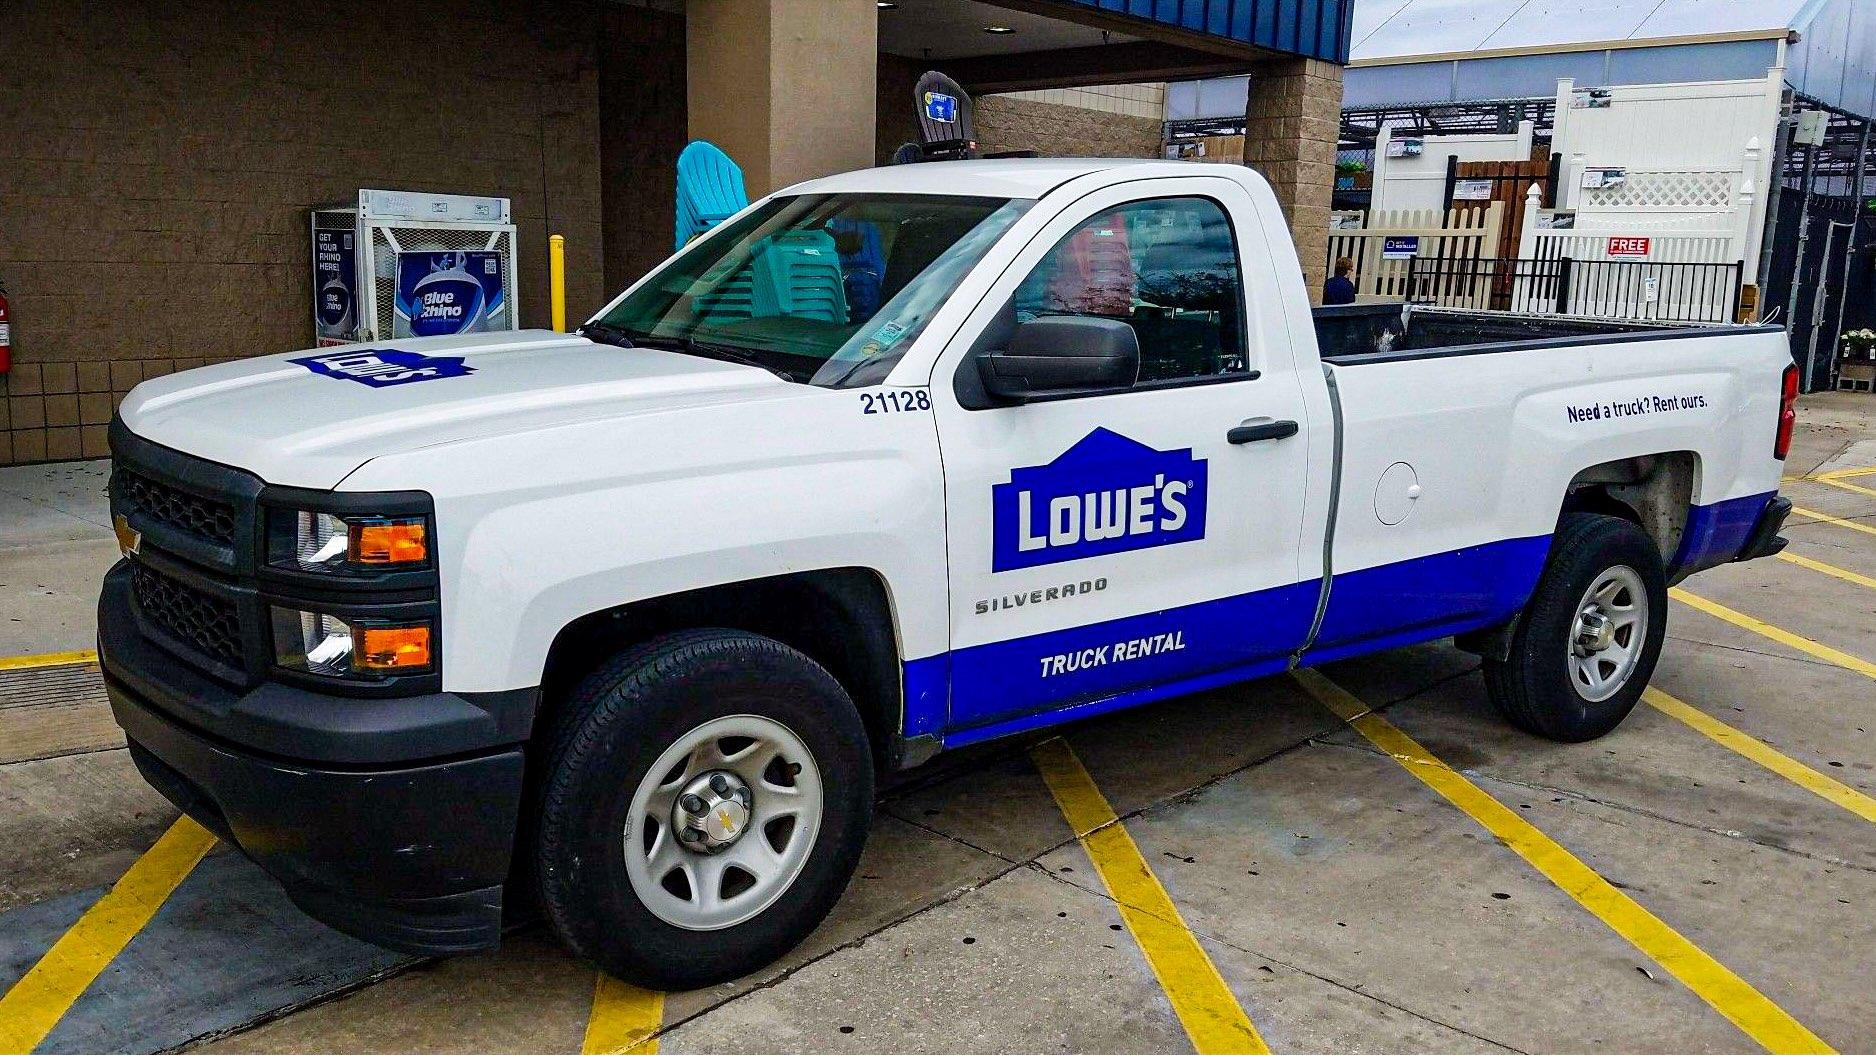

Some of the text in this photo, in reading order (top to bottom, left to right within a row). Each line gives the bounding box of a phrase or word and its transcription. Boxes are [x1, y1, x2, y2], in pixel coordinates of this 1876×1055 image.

[319, 233, 332, 242] GET
[319, 243, 337, 252] YOUR
[1609, 238, 1646, 251] FREE
[319, 252, 341, 262] RHINO
[860, 389, 931, 415] 21128
[1566, 394, 1708, 423] Need a truck? Rent ours.
[1017, 473, 1188, 552] LOWE'S
[974, 577, 1108, 615] SILVERADO
[1040, 631, 1186, 678] TRUCK RENTAL
